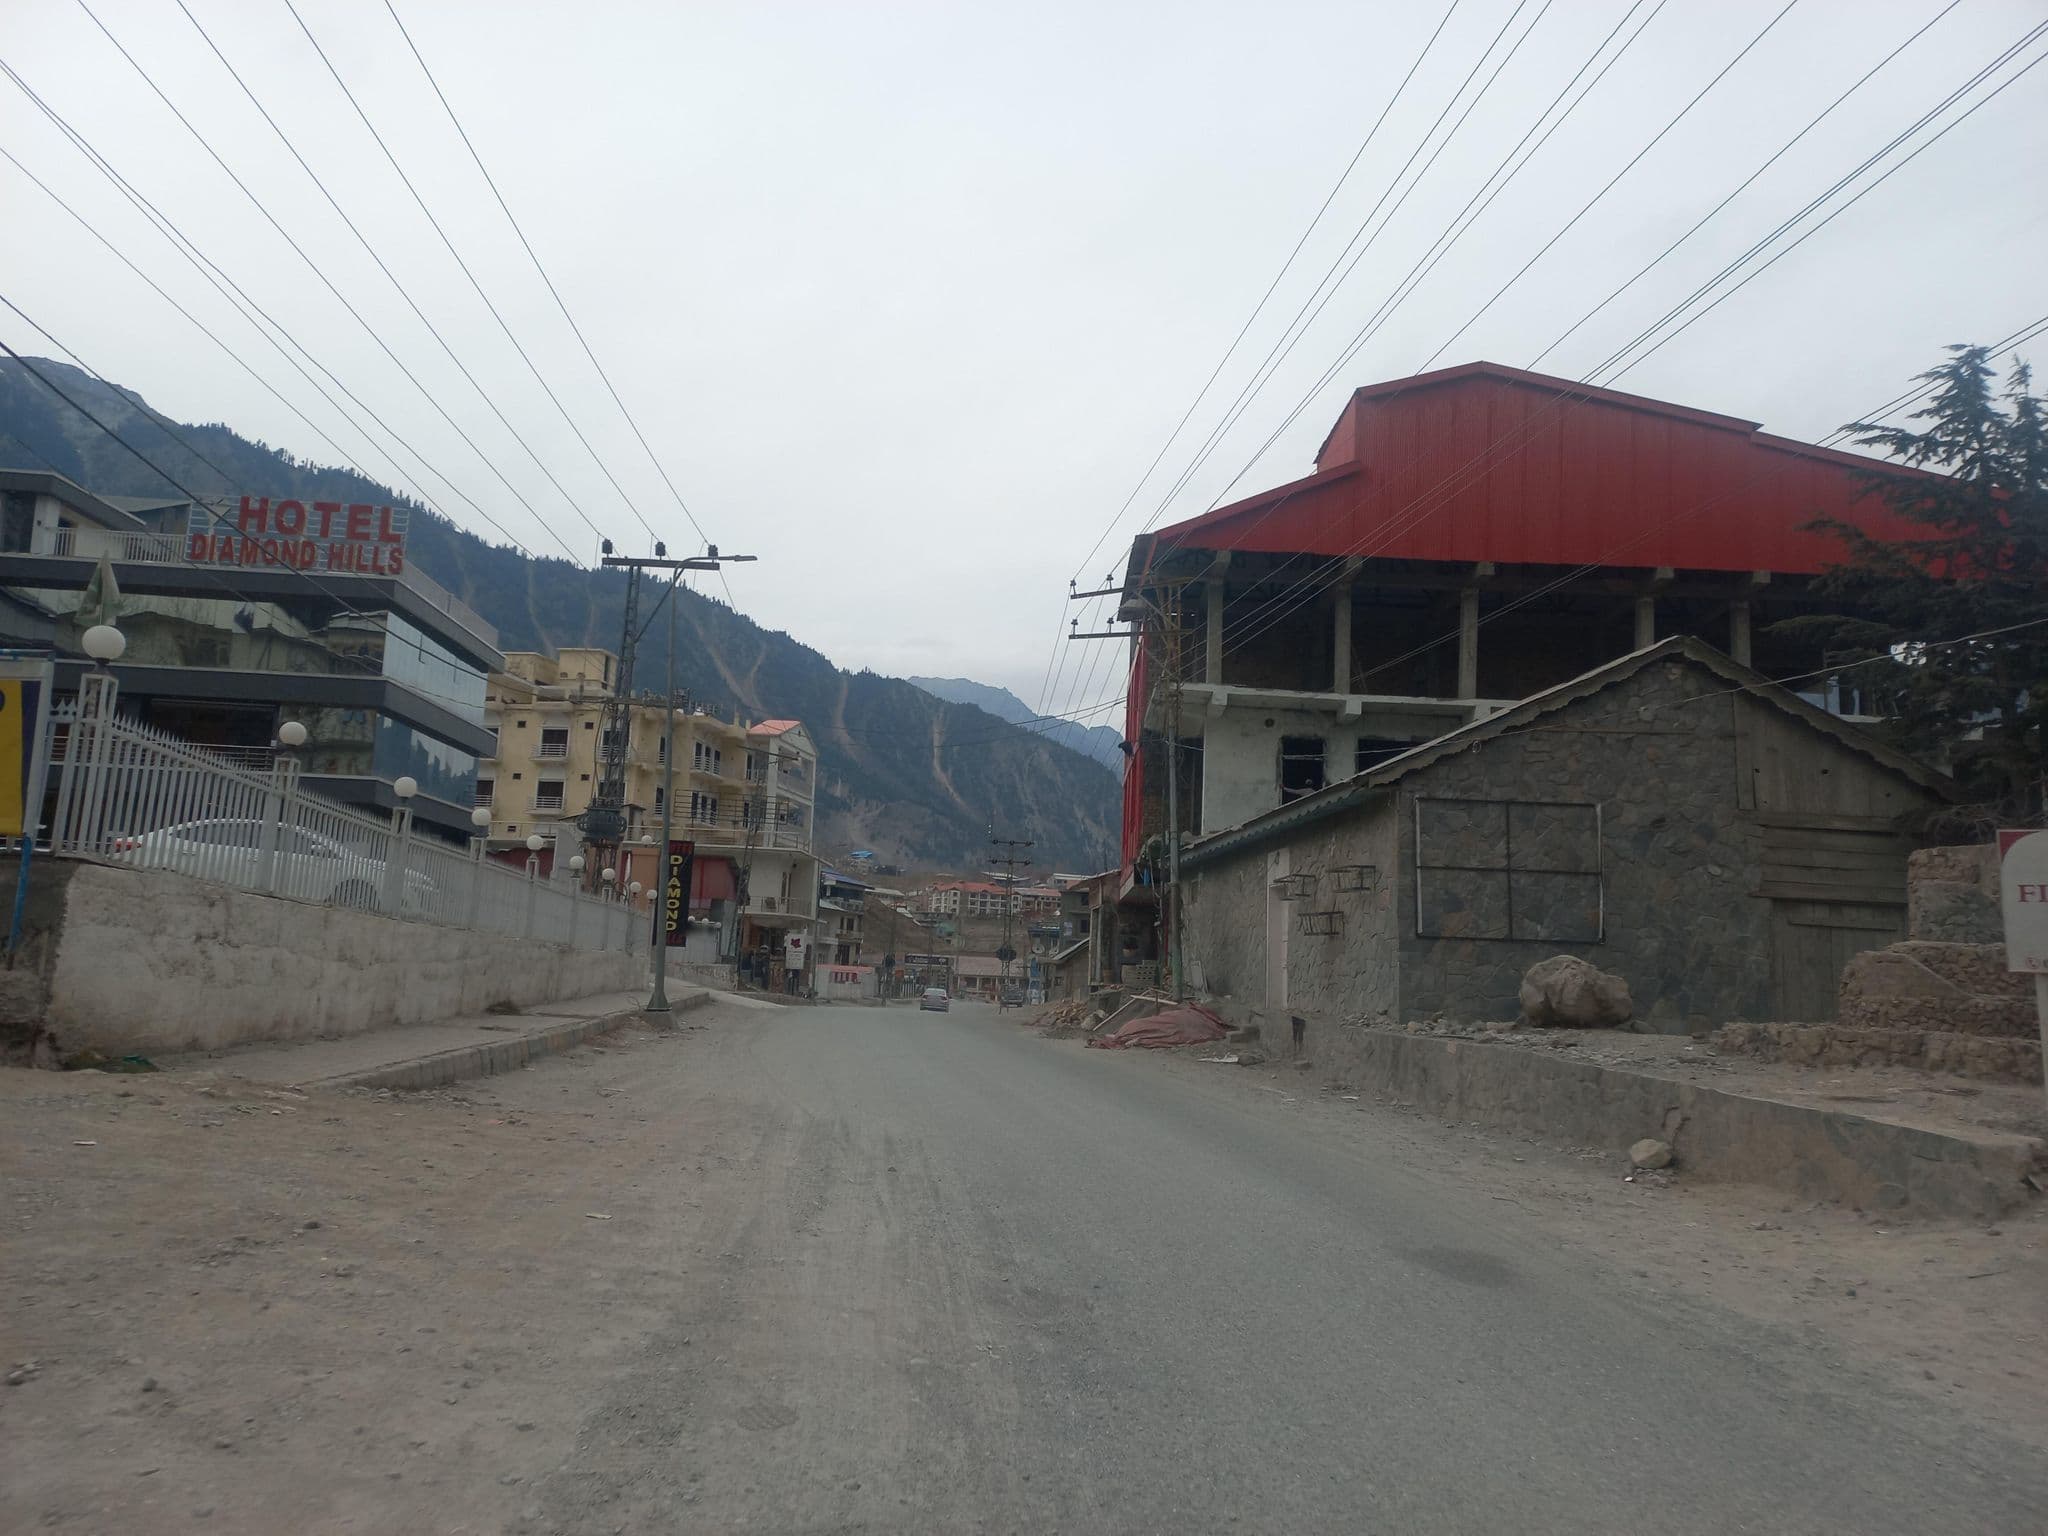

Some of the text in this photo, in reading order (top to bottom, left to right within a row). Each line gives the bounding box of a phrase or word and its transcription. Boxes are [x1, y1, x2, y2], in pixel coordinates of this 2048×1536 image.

[238, 495, 401, 543] HOTEL
[190, 532, 404, 575] DIAMOND HILLS
[665, 855, 684, 931] DIAMOND
